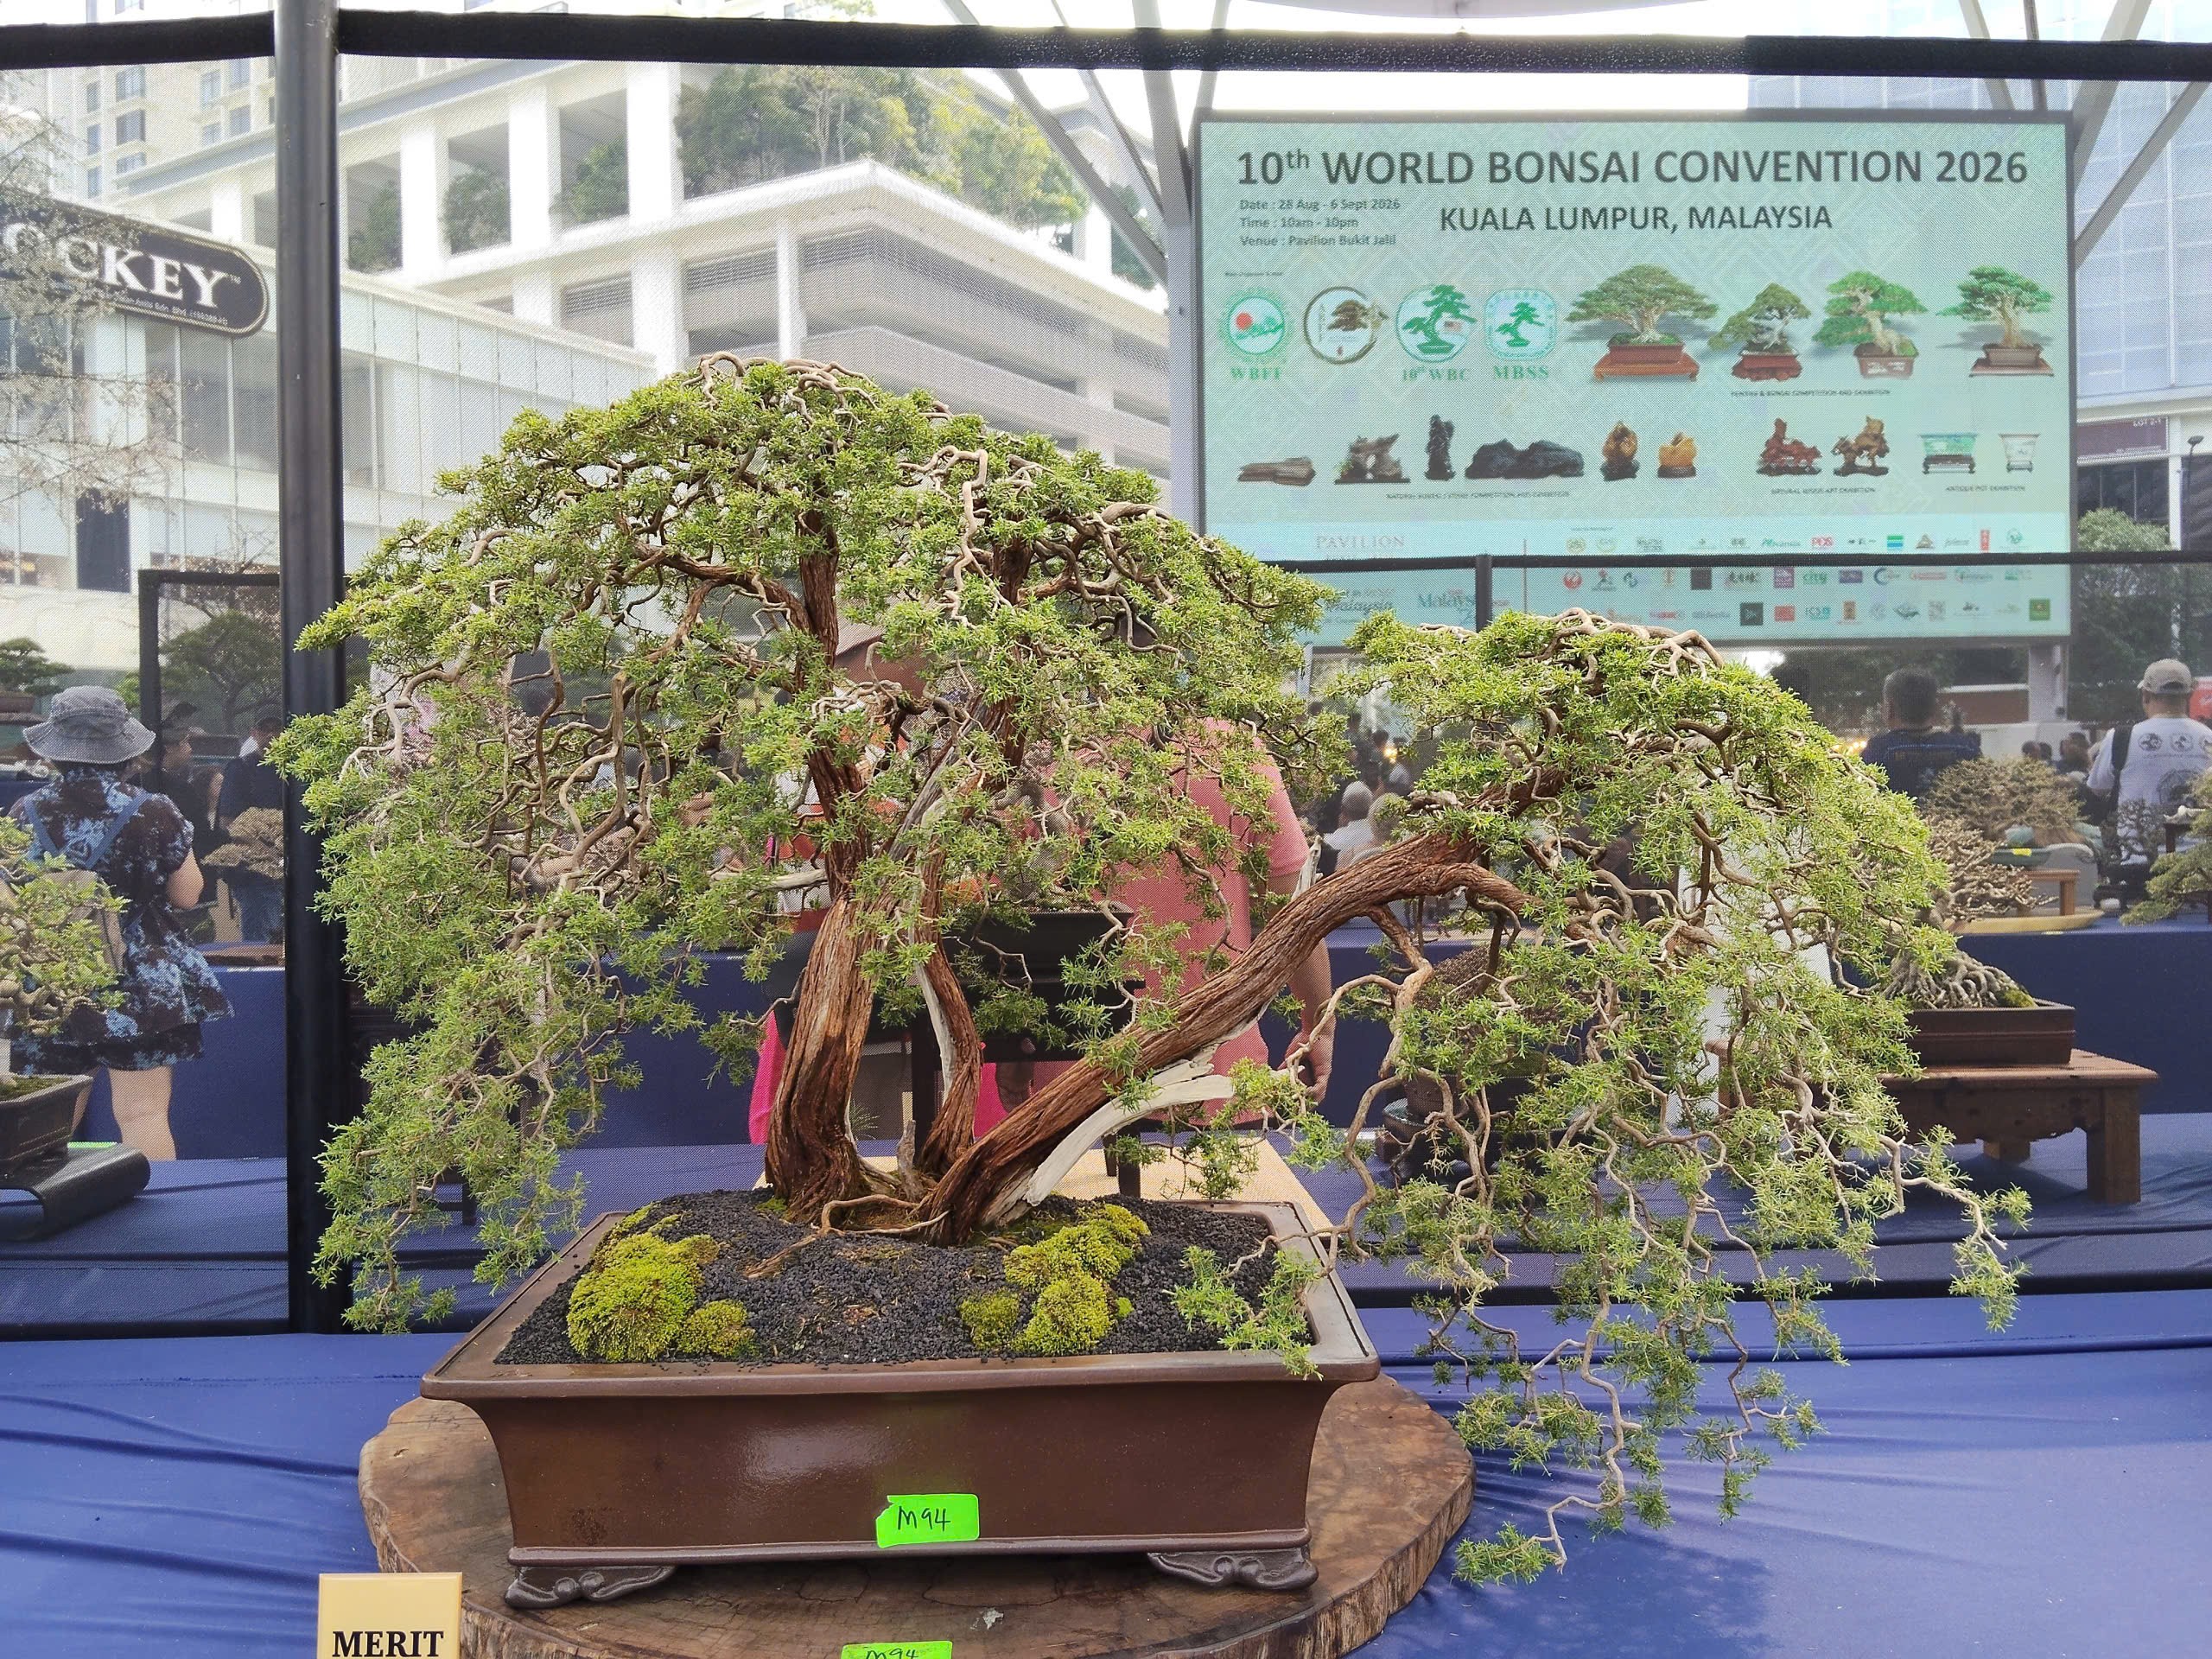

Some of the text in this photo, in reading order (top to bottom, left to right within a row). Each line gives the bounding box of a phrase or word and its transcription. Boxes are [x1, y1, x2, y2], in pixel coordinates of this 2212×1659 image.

[1238, 149, 2028, 185] 10th WORLD BONSAI CONVENTION 2026
[1239, 200, 1268, 210] Date
[1277, 200, 1294, 210] 28
[1296, 199, 1320, 211] Aug
[1330, 199, 1338, 209] 6
[1340, 199, 1367, 211] Sept
[1370, 198, 1402, 210] 2026
[1239, 217, 1270, 228] Time
[1280, 217, 1314, 228] 10am
[1325, 216, 1359, 230] 10pm
[1440, 205, 1833, 235] KUALA LUMPUR, MALAYSIA
[1239, 236, 1279, 246] Venue
[1288, 234, 1336, 246] Pavilion
[1339, 234, 1370, 246] Bukit
[1373, 234, 1396, 246] Jalil
[1492, 365, 1549, 380] MBSS
[1315, 534, 1405, 550] PAVILION
[897, 1505, 951, 1532] M94
[332, 1630, 444, 1657] MERIT
